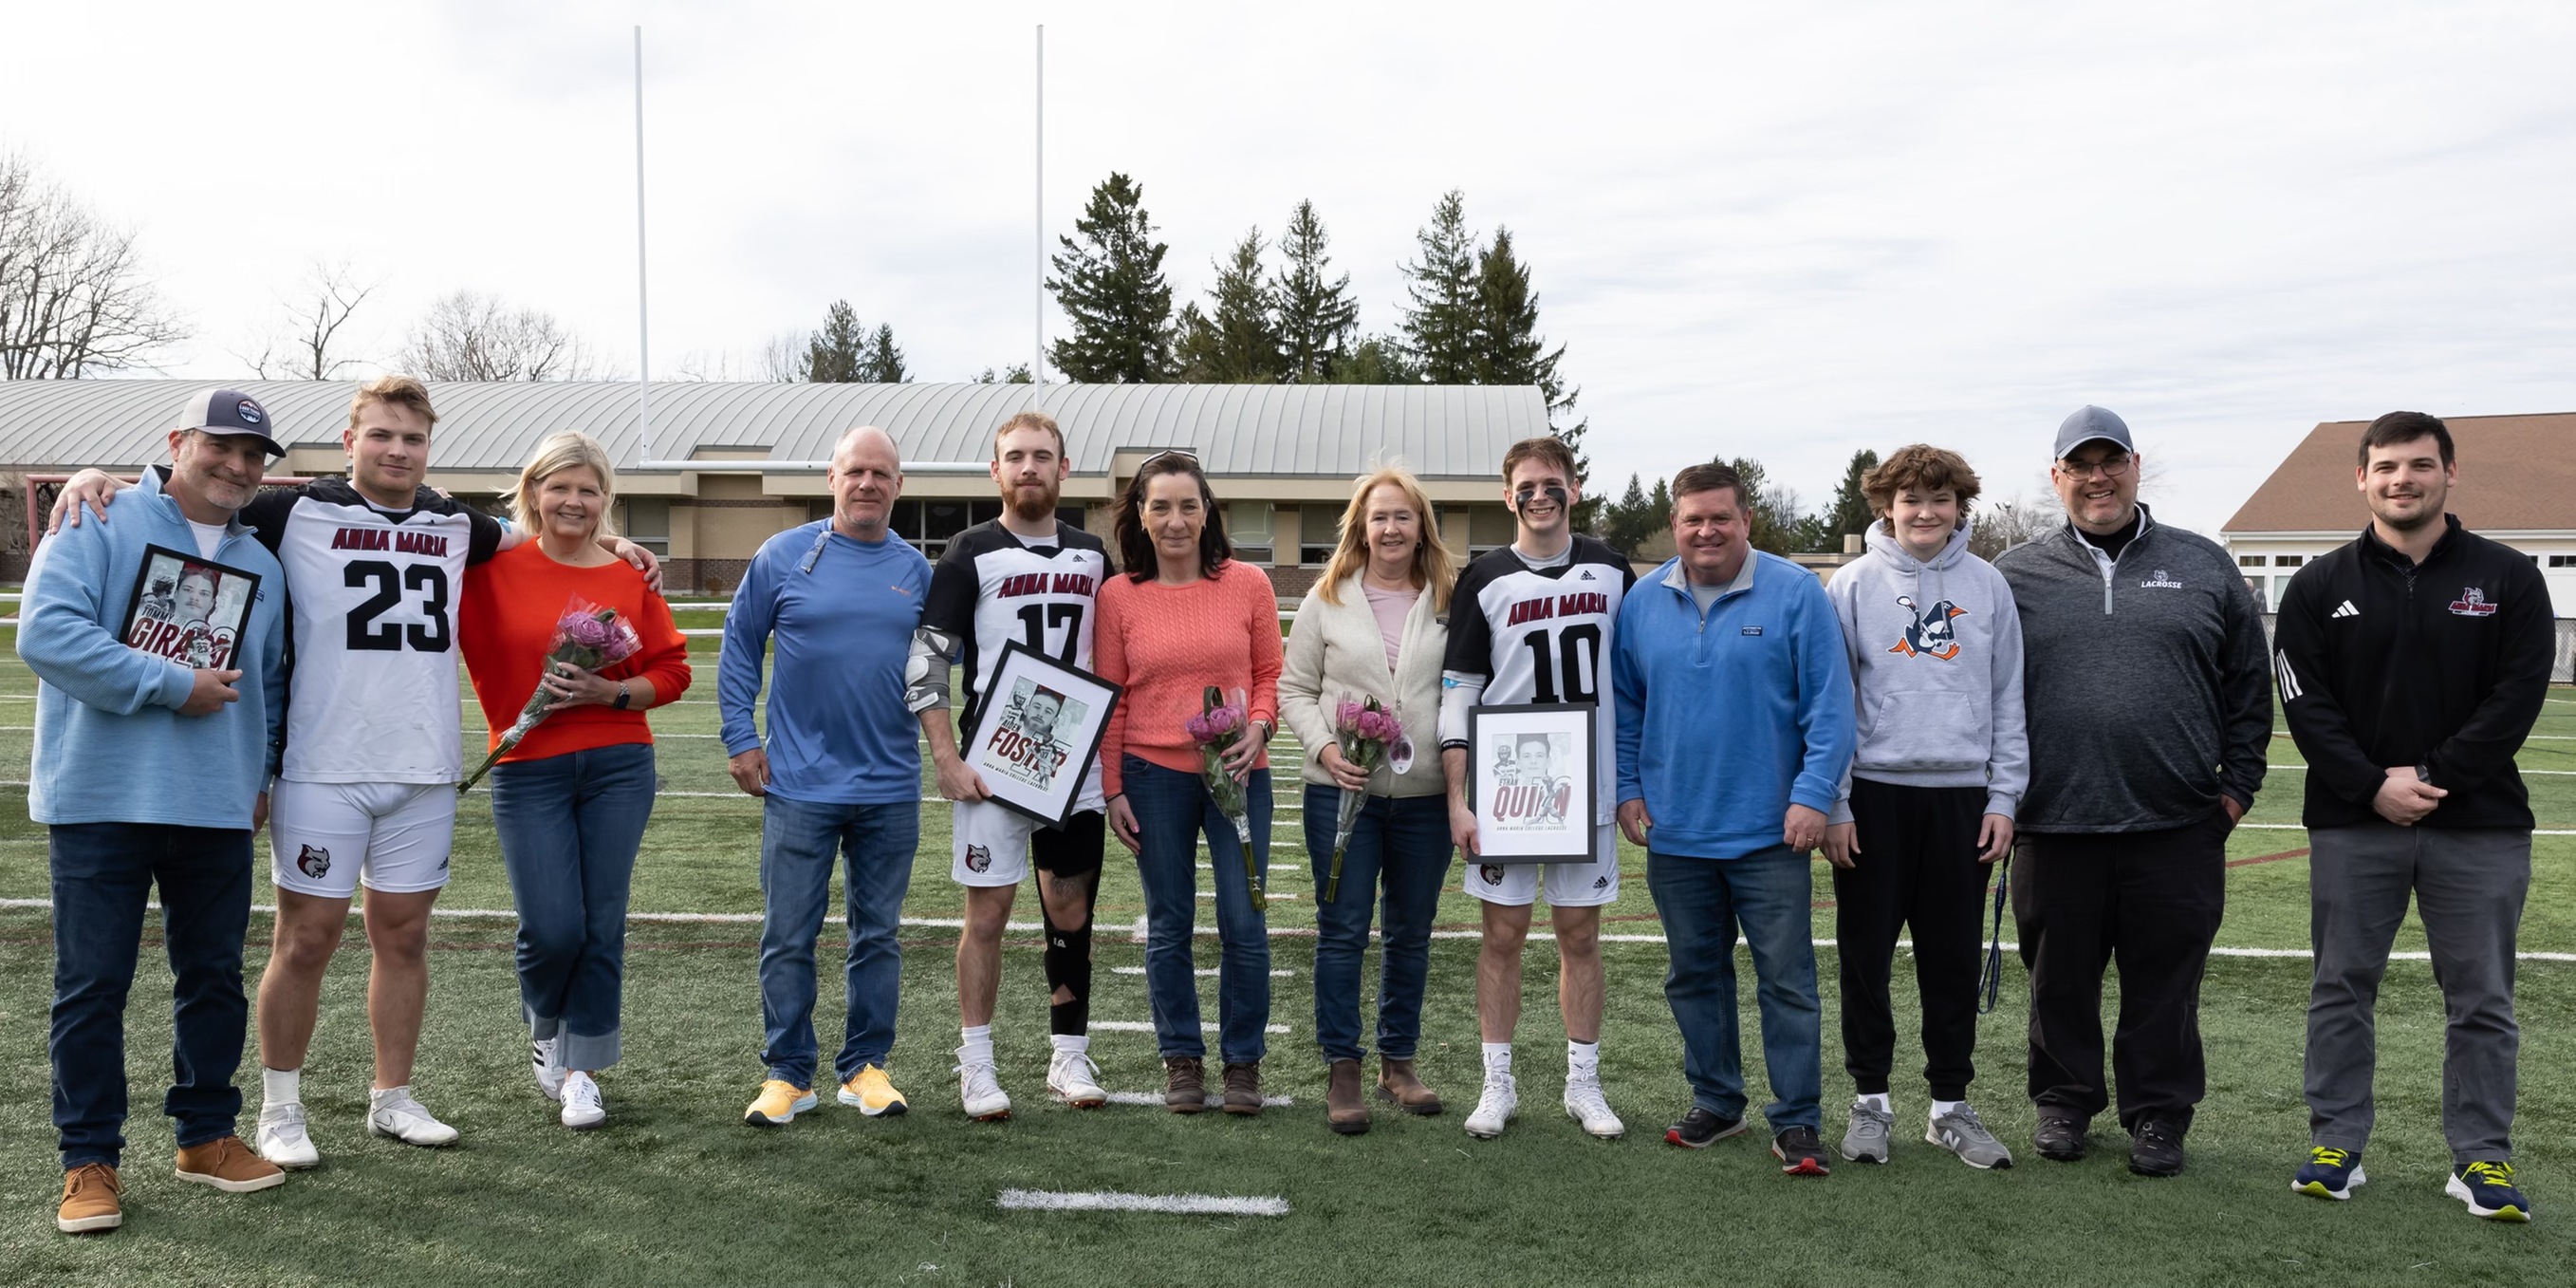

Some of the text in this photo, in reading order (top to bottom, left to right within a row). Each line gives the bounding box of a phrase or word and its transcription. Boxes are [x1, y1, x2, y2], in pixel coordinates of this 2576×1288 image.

[331, 528, 448, 558] ANNA MARIA
[343, 560, 451, 653] 23
[997, 572, 1094, 599] ANNA MARIA
[141, 605, 175, 623] TOMMY
[1507, 592, 1607, 627] ANNA MARIA
[126, 617, 232, 668] GIRAD
[1017, 603, 1084, 666] 17
[1524, 623, 1601, 707] 10
[1001, 719, 1022, 732] AIDEN
[987, 726, 1067, 778] FOSTR
